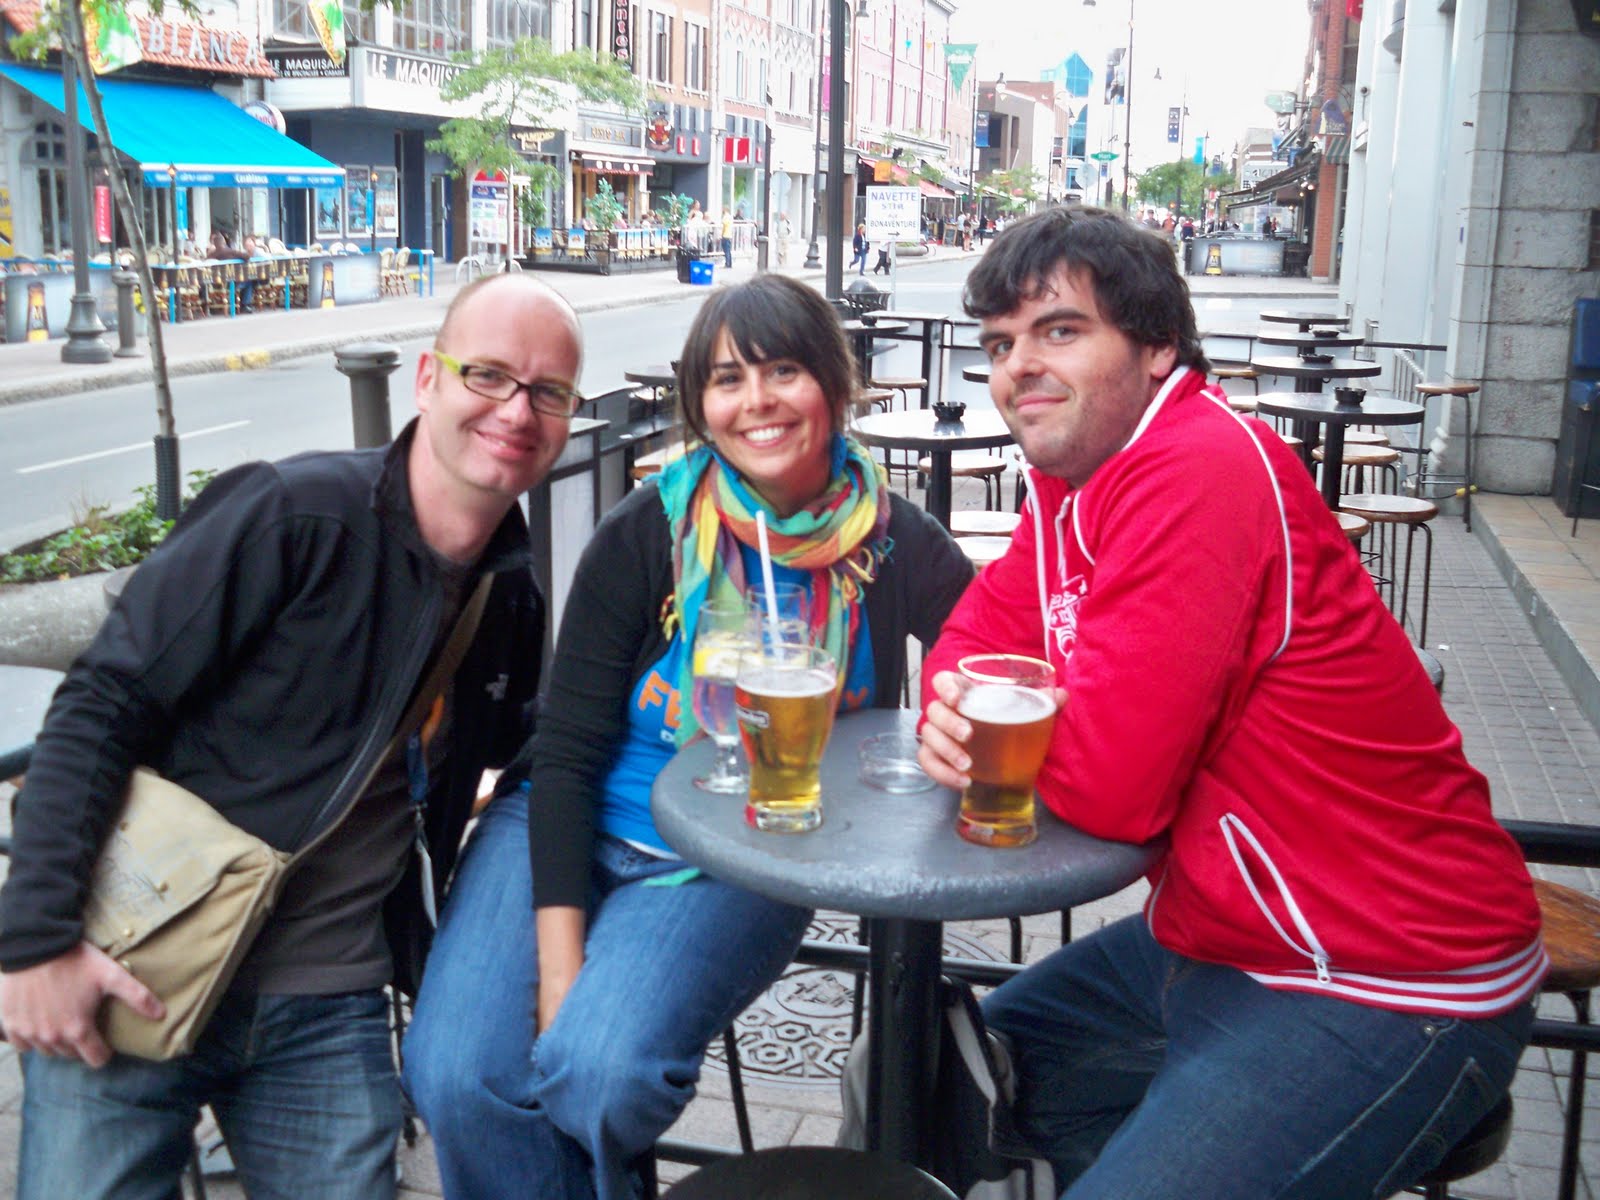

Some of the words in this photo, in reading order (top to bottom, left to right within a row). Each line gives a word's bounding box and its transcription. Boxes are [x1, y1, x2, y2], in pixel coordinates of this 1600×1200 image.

[371, 53, 388, 79] LE
[396, 58, 460, 89] MAQUIS
[871, 191, 918, 201] NAVETTE
[870, 220, 917, 228] BONAVENTURE
